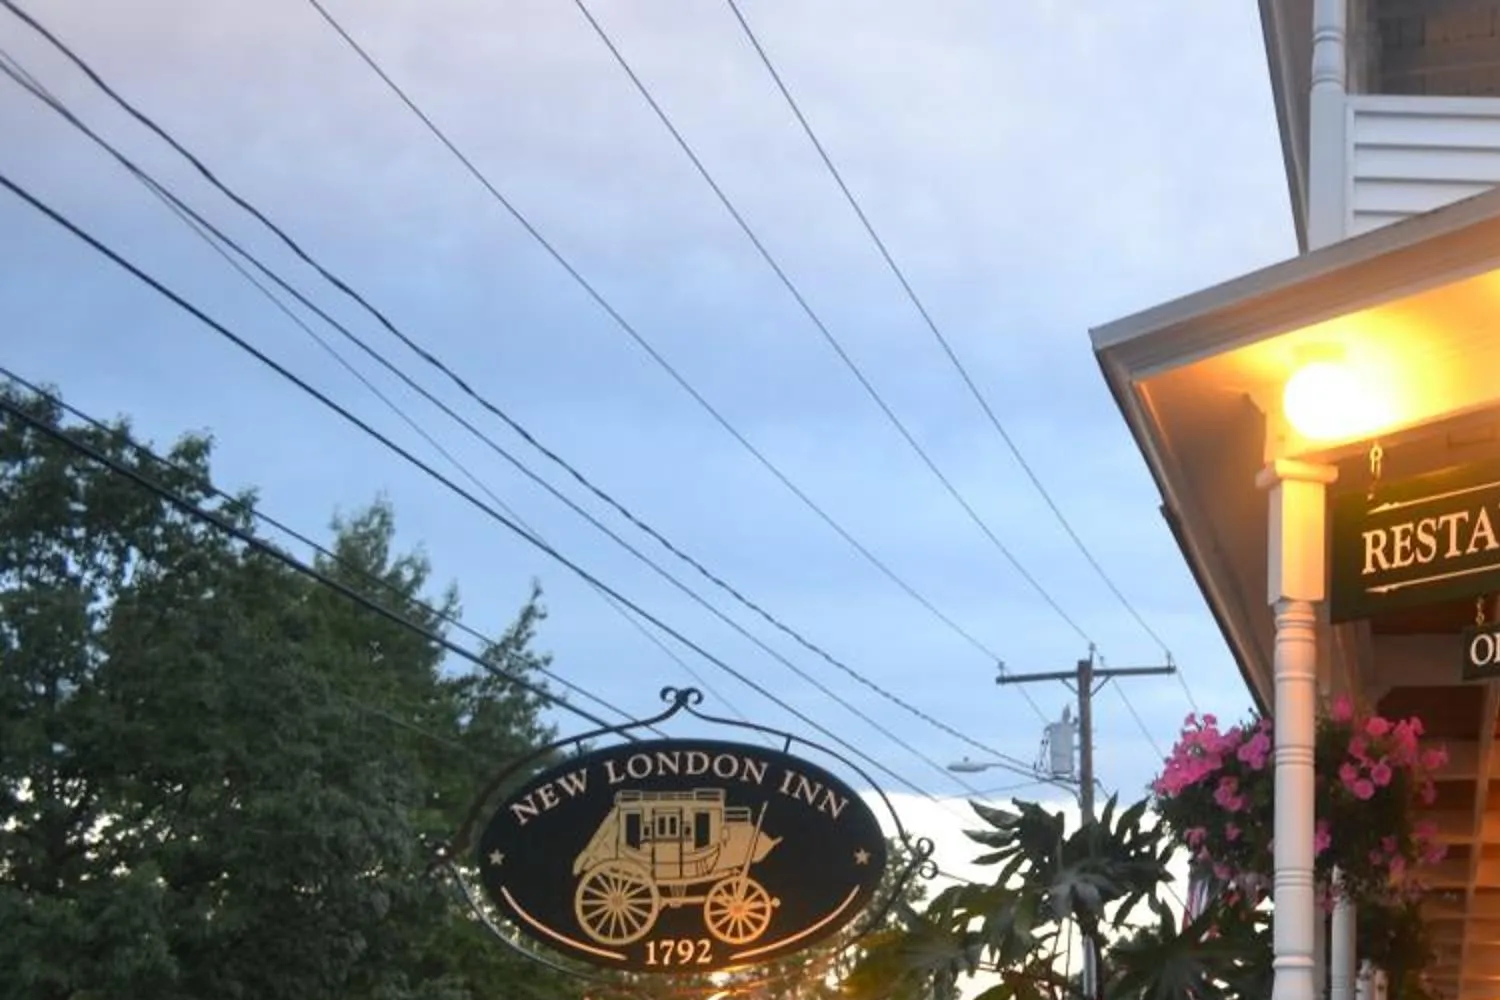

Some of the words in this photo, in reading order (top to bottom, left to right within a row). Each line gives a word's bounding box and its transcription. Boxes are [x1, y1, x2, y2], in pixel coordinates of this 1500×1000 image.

[510, 769, 589, 826] NEW
[606, 750, 769, 785] LONDON
[780, 771, 849, 821] INN
[644, 938, 713, 966] 1792
